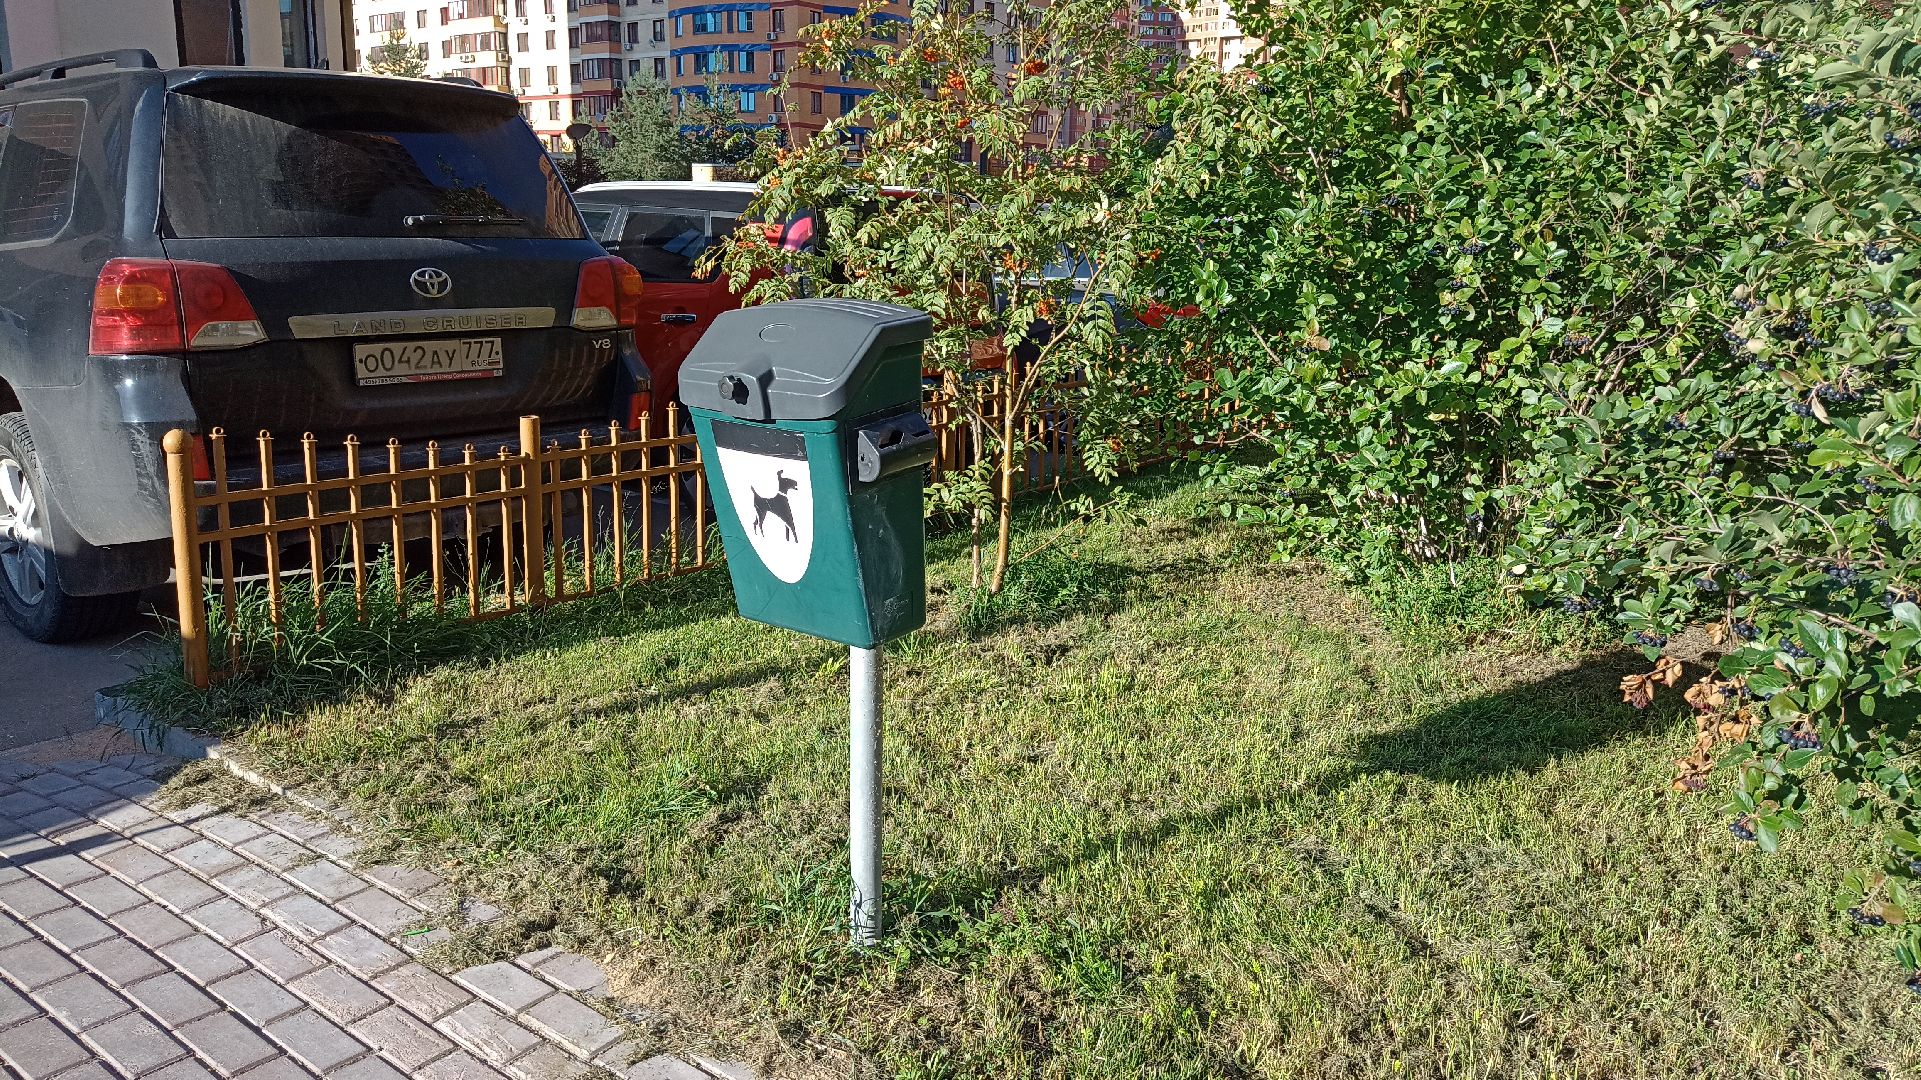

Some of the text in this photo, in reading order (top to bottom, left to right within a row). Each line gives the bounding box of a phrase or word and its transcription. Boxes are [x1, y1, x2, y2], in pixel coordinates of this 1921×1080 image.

[332, 313, 528, 336] LAND CRUISER
[461, 340, 495, 360] 777
[591, 338, 611, 349] V8
[470, 359, 488, 368] RUS
